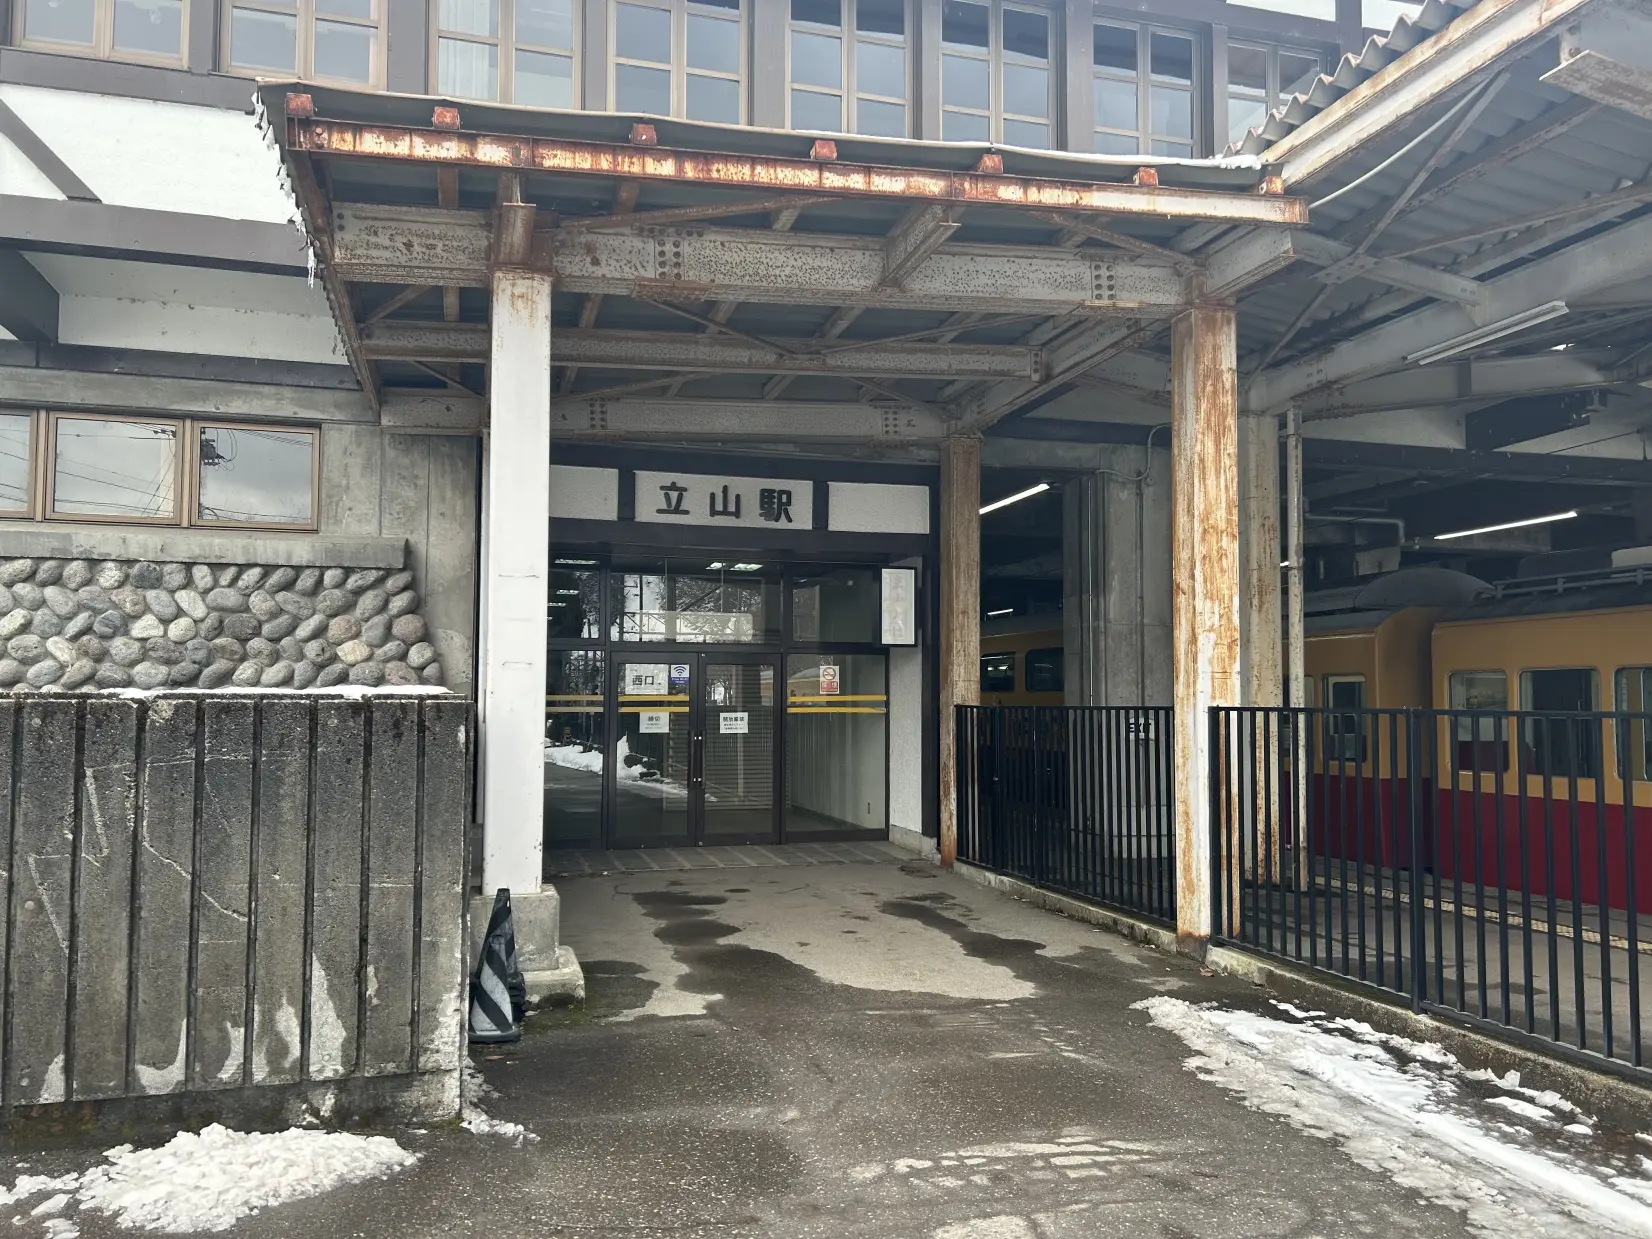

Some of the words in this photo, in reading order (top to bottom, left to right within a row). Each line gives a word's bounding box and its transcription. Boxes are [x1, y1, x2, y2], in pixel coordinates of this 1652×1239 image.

[656, 481, 792, 523] 立山駅
[632, 675, 654, 685] 西口
[1128, 722, 1152, 734] EXI
